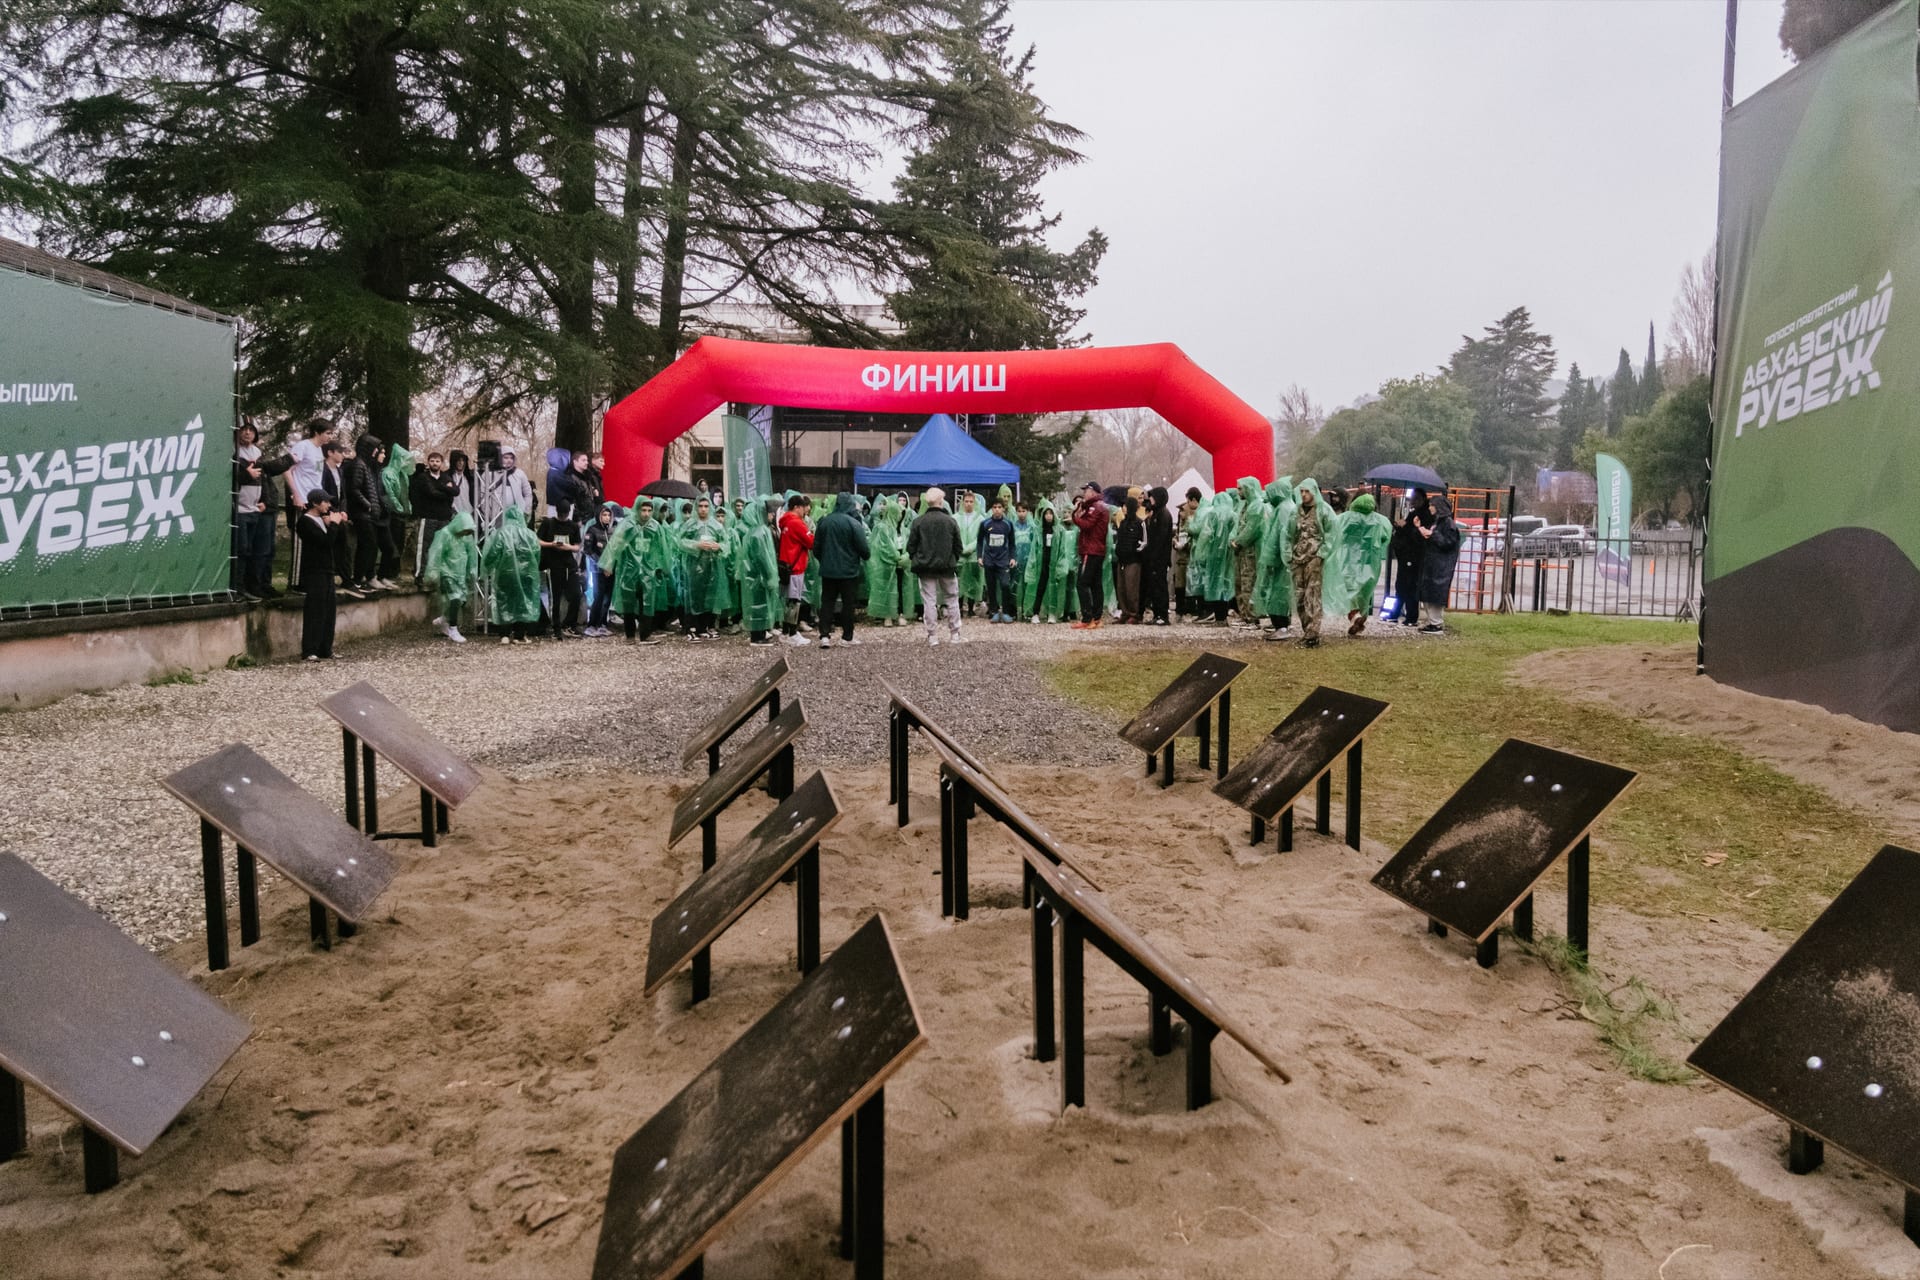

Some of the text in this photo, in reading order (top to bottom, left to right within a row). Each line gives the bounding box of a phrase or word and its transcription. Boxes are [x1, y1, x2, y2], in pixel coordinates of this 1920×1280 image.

[861, 363, 1007, 392] ФИНИШ
[1735, 327, 1886, 438] РУБЕЖ
[1742, 269, 1893, 393] АБХАЗСКИЙ
